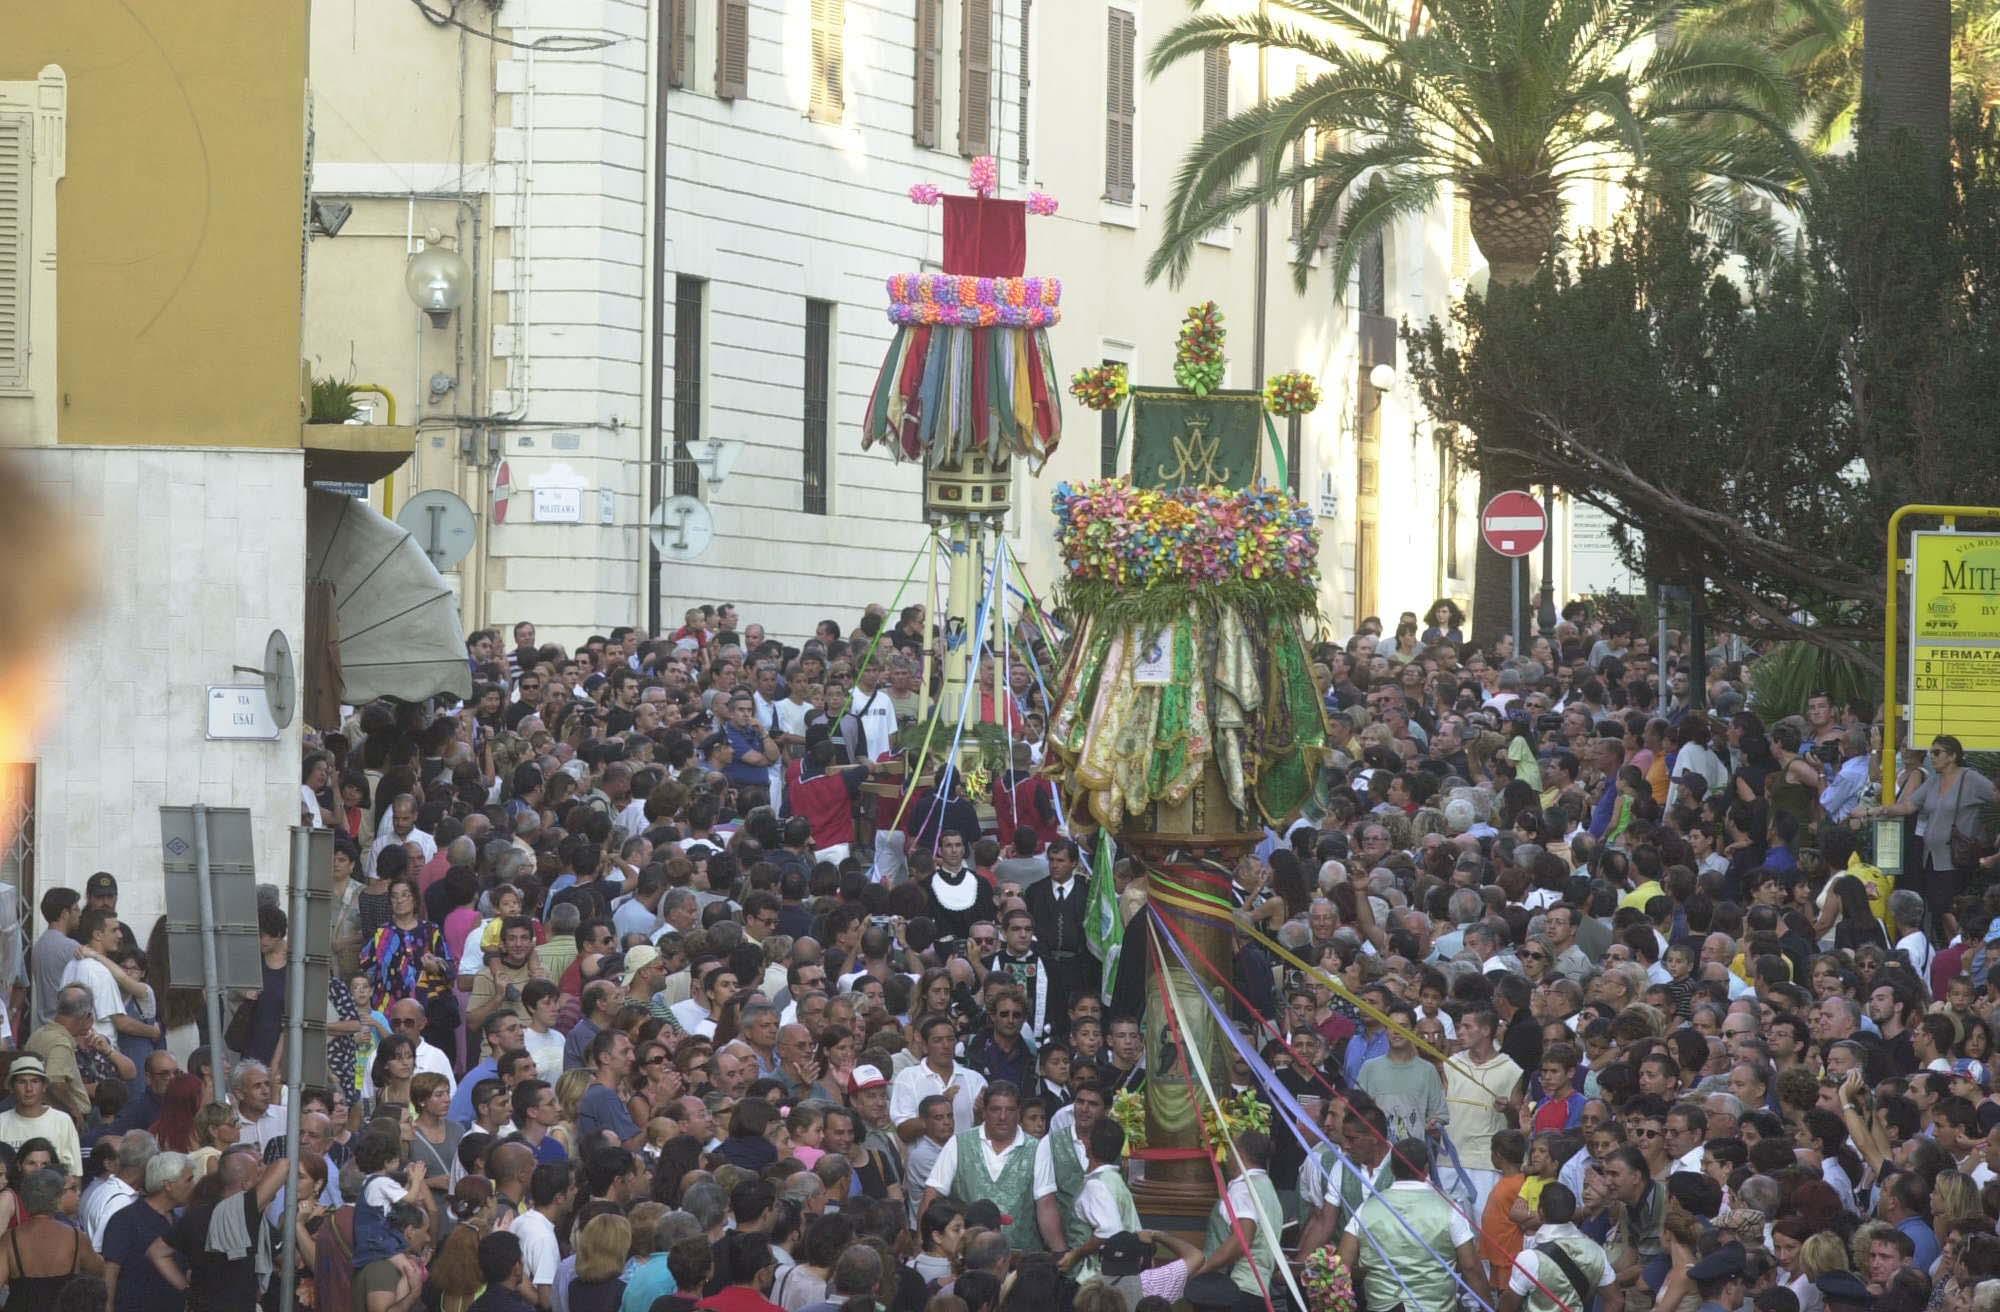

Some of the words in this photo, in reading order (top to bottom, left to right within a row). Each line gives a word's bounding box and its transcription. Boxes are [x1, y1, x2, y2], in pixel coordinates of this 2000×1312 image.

[1982, 606, 1999, 616] BY
[1931, 649, 2000, 660] FERMATA
[237, 696, 250, 705] VIA
[232, 713, 254, 725] USAI
